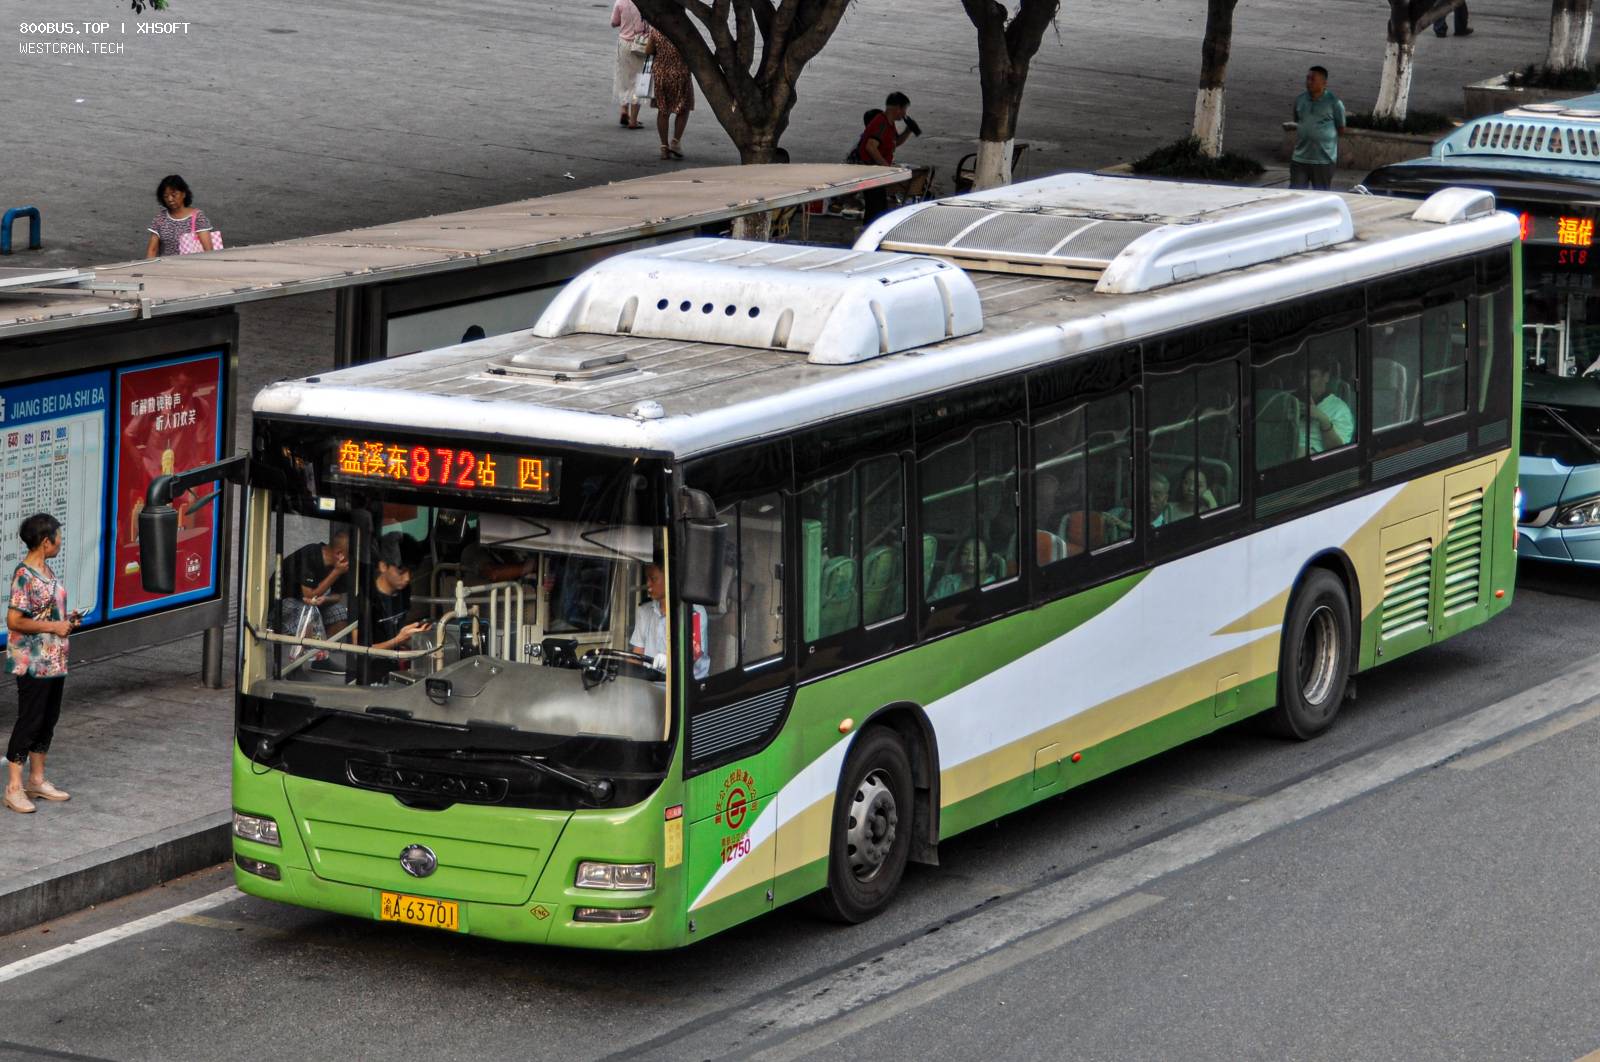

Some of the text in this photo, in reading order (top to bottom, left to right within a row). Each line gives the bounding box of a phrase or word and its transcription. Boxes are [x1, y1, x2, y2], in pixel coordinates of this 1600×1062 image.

[11, 399, 40, 420] JIANG
[43, 396, 57, 413] BEI
[59, 393, 72, 411] DA
[74, 389, 90, 407] SHI
[92, 387, 105, 405] BA
[40, 430, 51, 442] 872
[339, 440, 408, 480] 盘溪东
[410, 446, 477, 489] 872
[518, 458, 543, 492] 四
[720, 838, 751, 865] 12750
